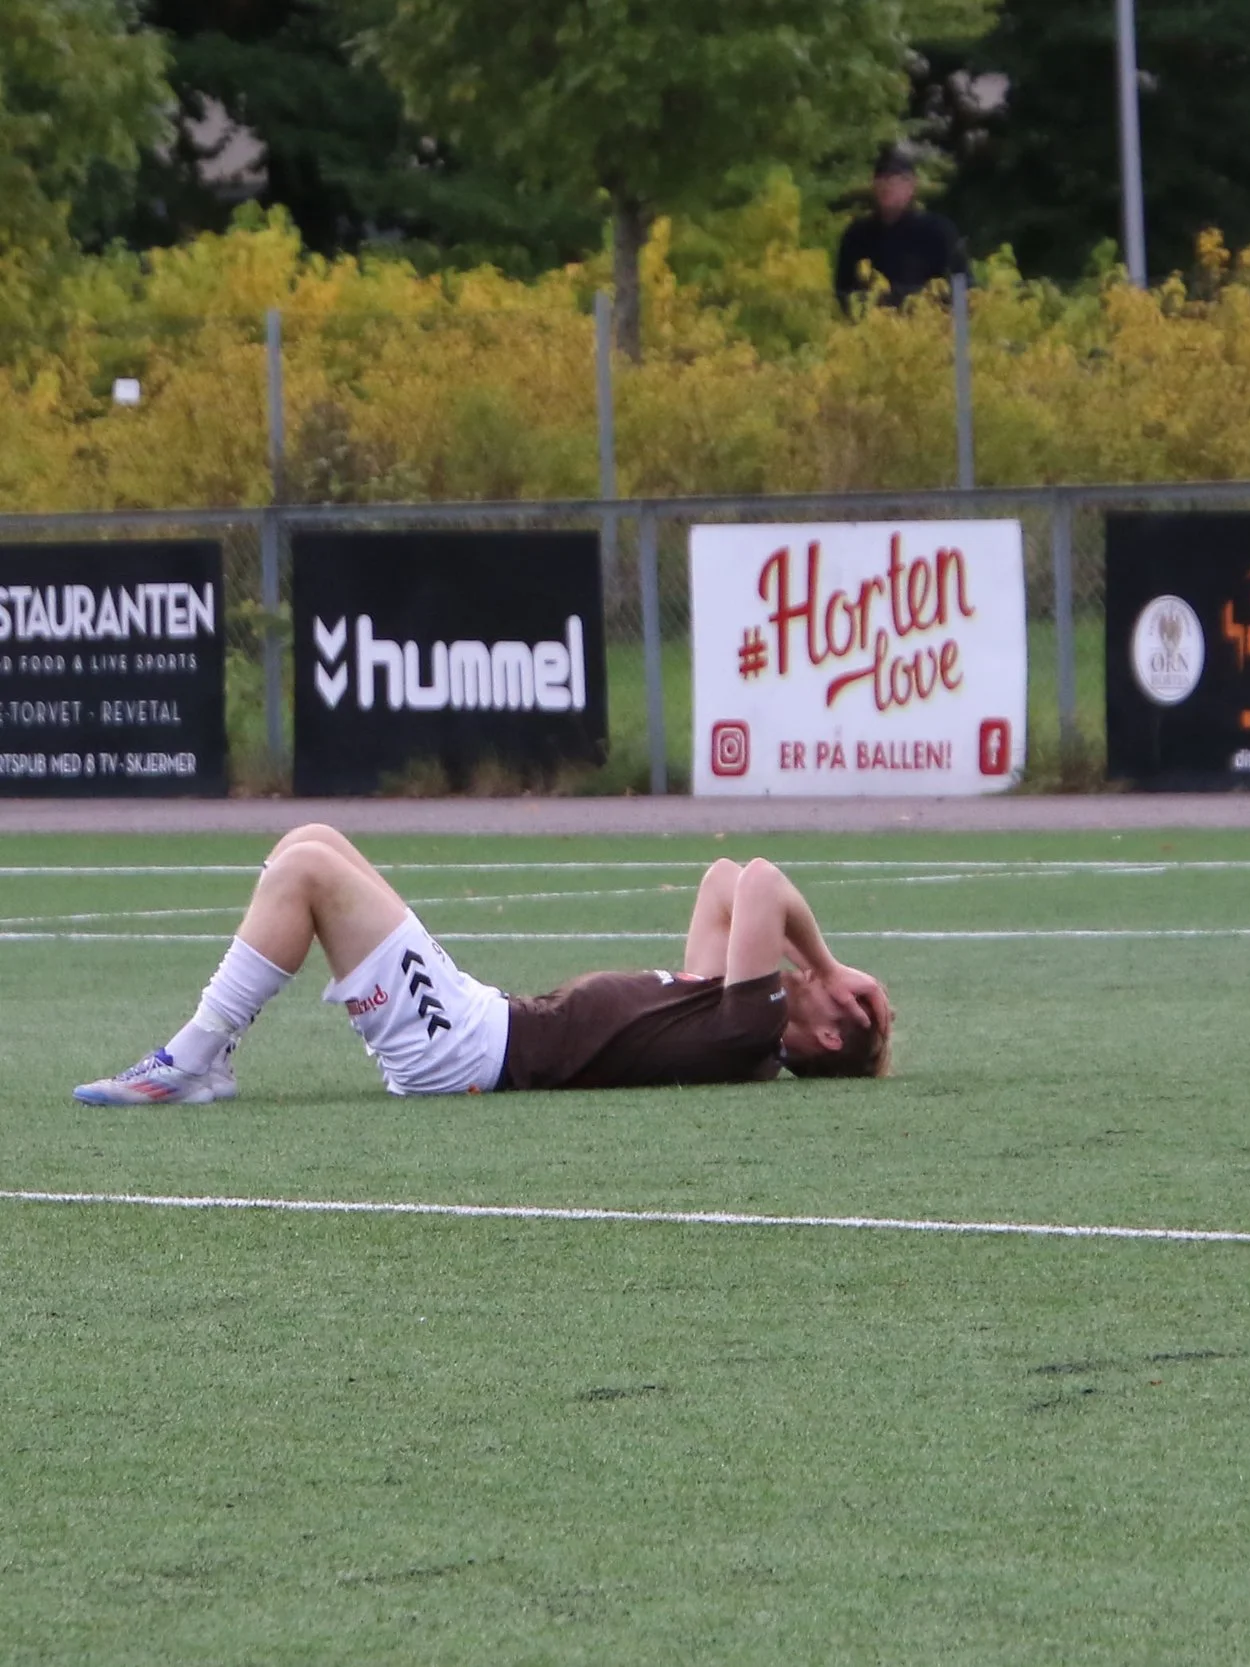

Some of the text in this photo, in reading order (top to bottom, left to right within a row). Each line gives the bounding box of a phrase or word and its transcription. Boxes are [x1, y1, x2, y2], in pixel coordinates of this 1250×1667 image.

[19, 654, 65, 673] FOOD
[91, 653, 127, 673] LIVE
[136, 652, 197, 673] SPORTS
[356, 613, 586, 711] hummel
[826, 627, 964, 712] love
[102, 699, 181, 724] REVETAL
[50, 752, 82, 777] MED
[780, 741, 806, 769] ER
[856, 740, 953, 769] BALLEN!
